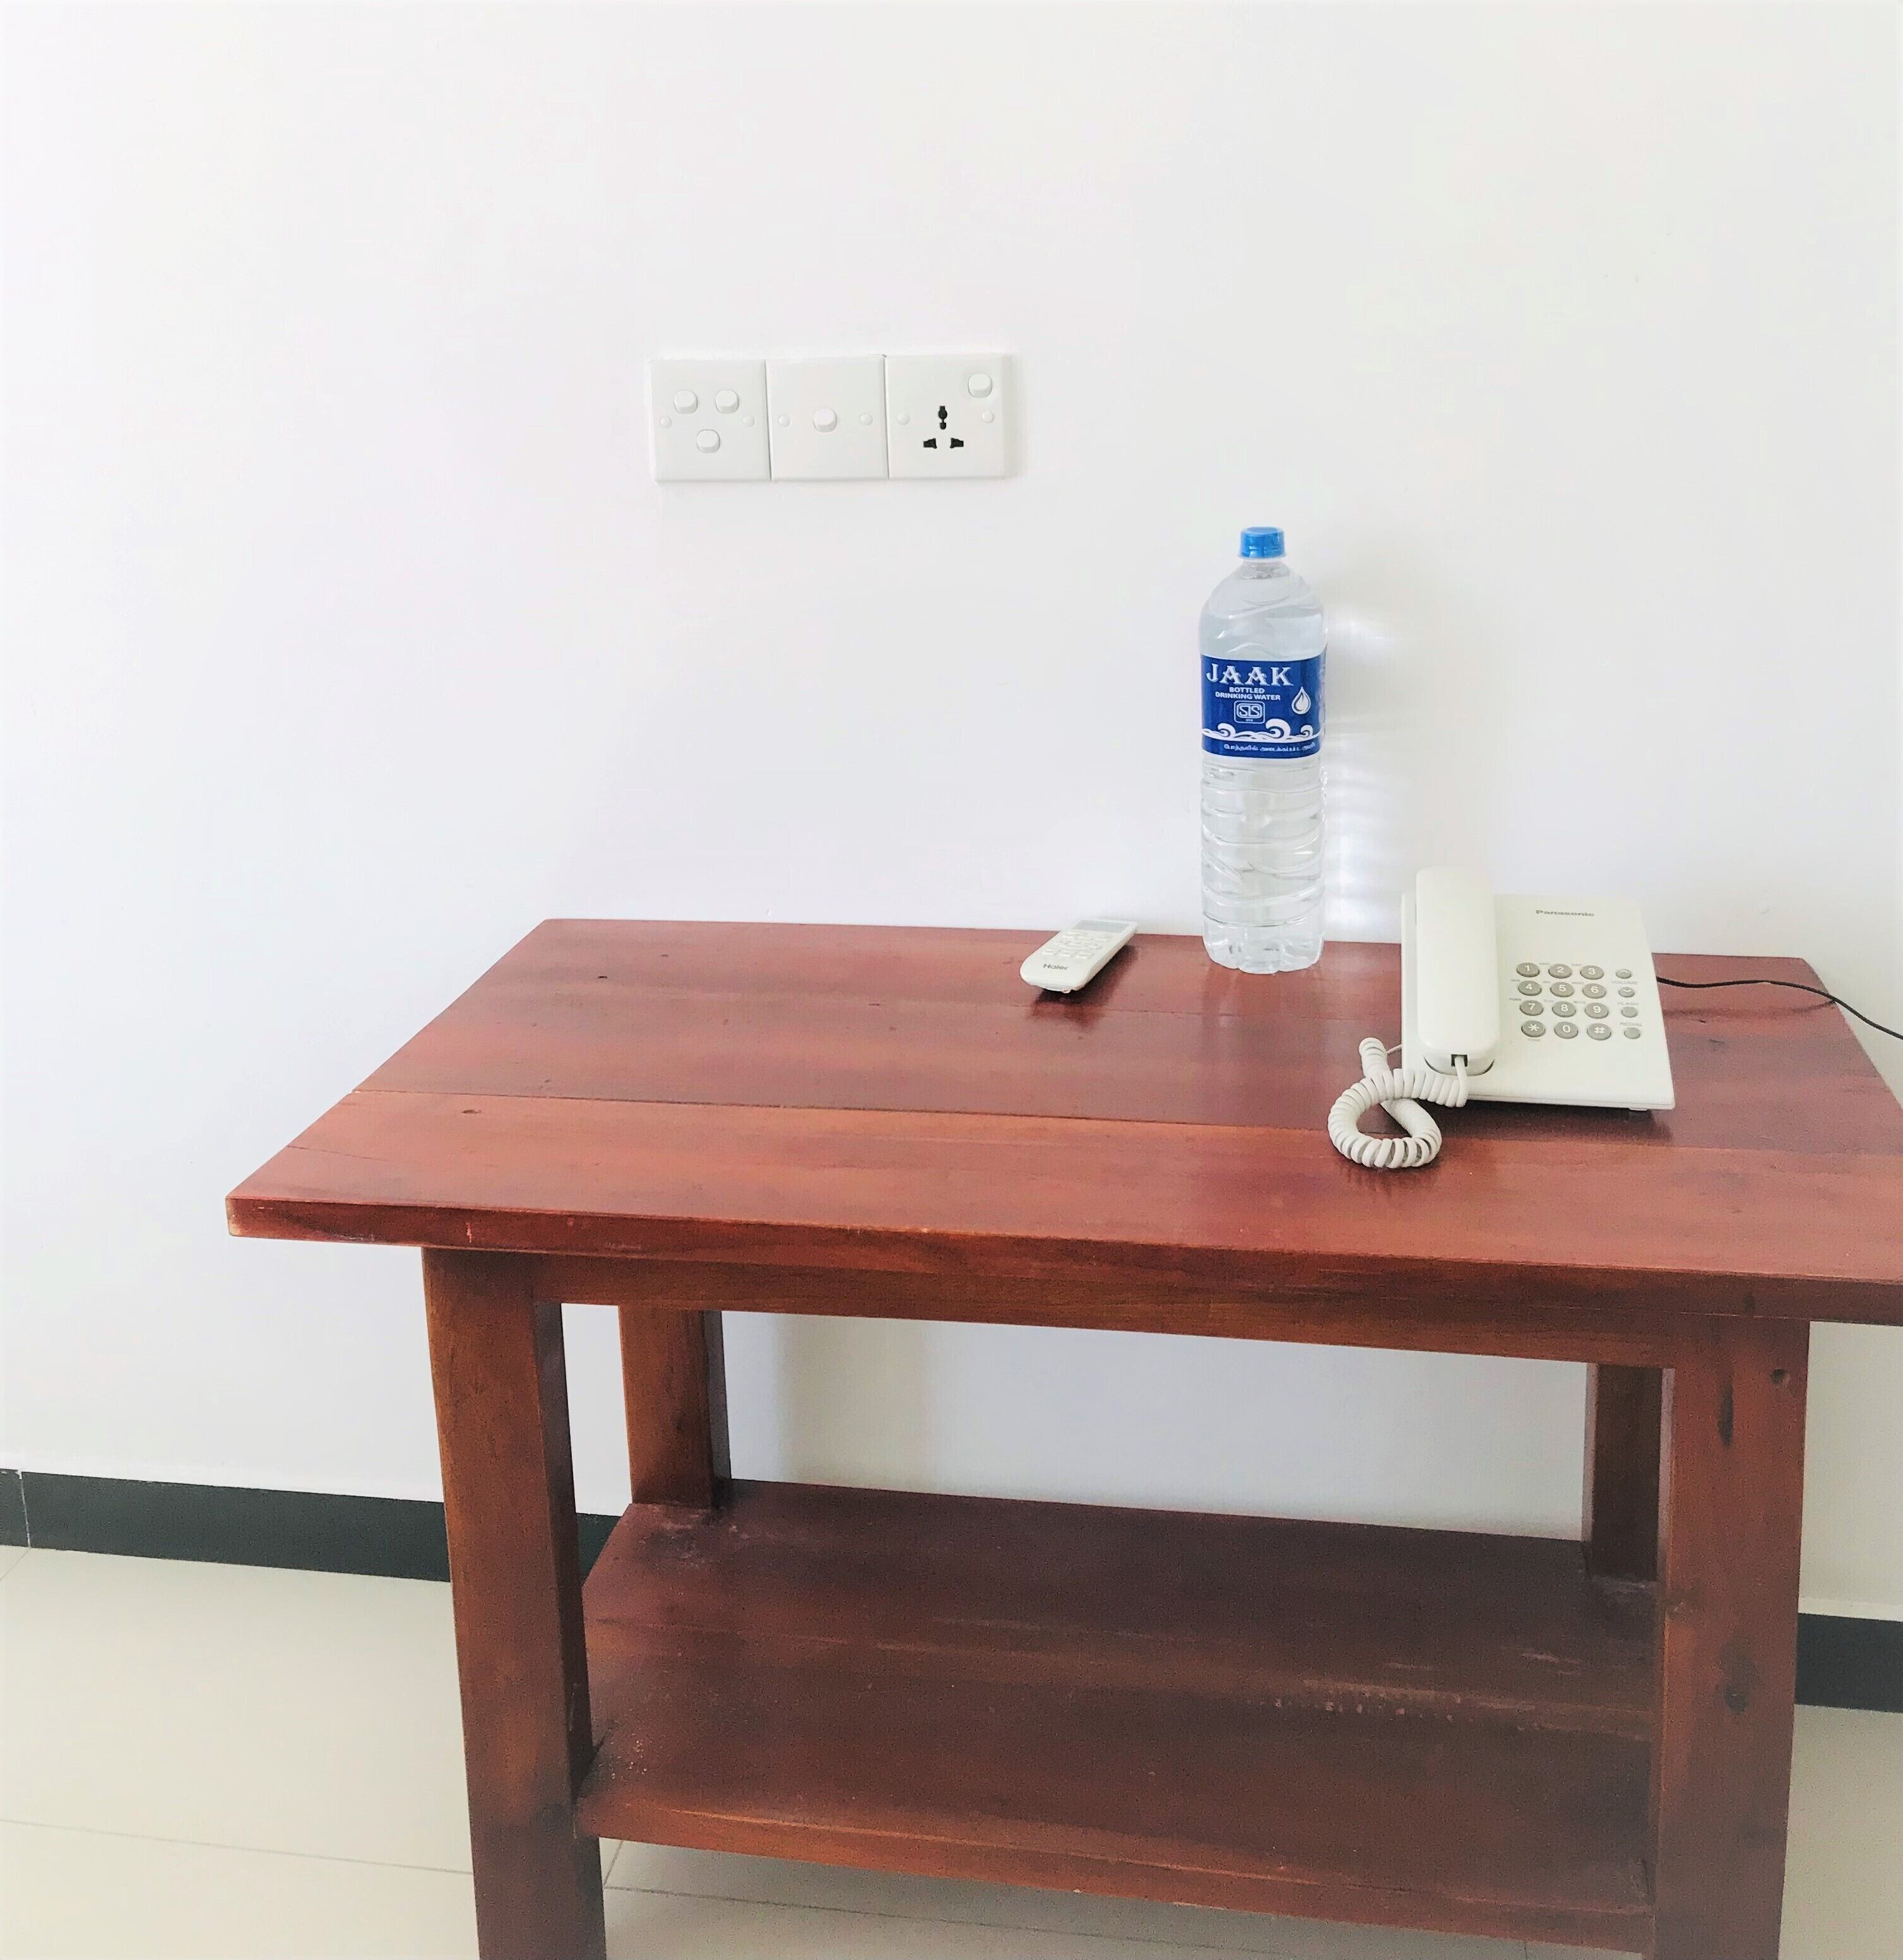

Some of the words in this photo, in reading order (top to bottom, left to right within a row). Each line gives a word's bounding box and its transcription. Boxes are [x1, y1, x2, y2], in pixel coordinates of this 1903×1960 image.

[1206, 663, 1294, 687] JAAK
[1215, 691, 1252, 700] DRINKING
[1591, 986, 1599, 994] 6
[1527, 1002, 1536, 1011] 7
[1560, 1004, 1568, 1012] 8
[1592, 1005, 1601, 1013] 9
[1562, 1025, 1571, 1033] 0
